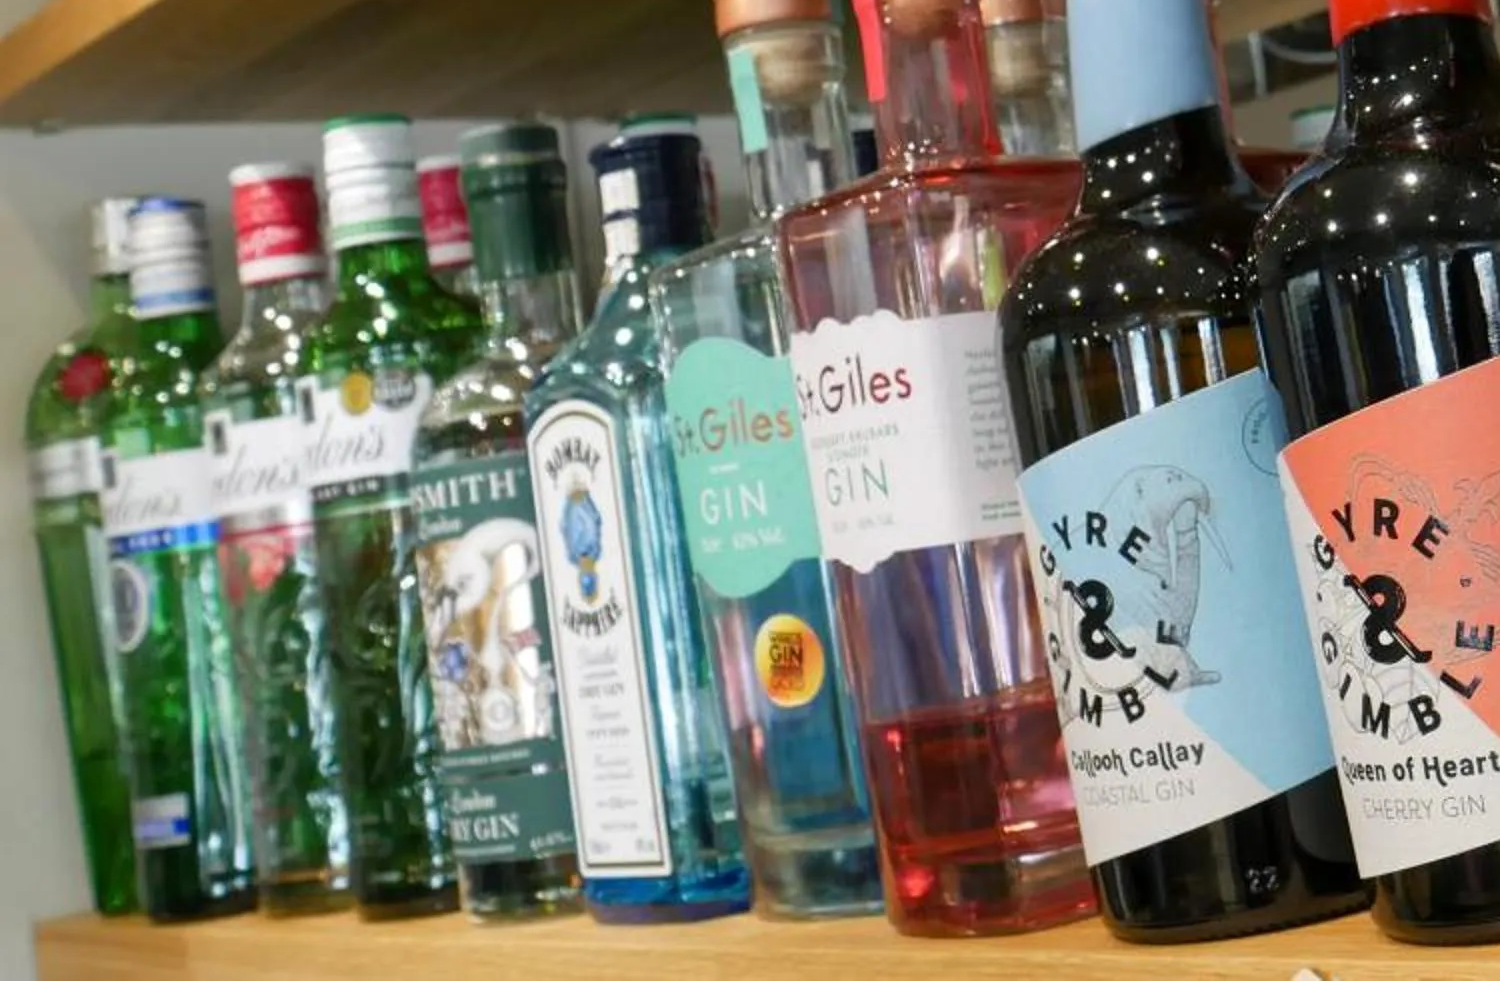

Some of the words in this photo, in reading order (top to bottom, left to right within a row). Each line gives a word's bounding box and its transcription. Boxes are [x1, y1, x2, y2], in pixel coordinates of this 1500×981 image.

[409, 468, 517, 514] SMITH
[700, 478, 768, 526] GIN
[824, 457, 890, 507] GIN
[1039, 510, 1151, 578] GYRE
[1311, 497, 1449, 571] GYRE
[769, 643, 804, 668] GIN
[1047, 619, 1179, 728] GIMBLE
[1319, 619, 1494, 739] GIMBLE
[1070, 747, 1129, 779] Callooh
[1129, 740, 1205, 772] Callay
[1341, 755, 1387, 786] Queen
[1392, 756, 1415, 782] of
[1082, 783, 1151, 807] COASTAL
[1155, 778, 1196, 802] GIN
[1362, 797, 1434, 821] CHERRY
[1441, 794, 1487, 819] GIN
